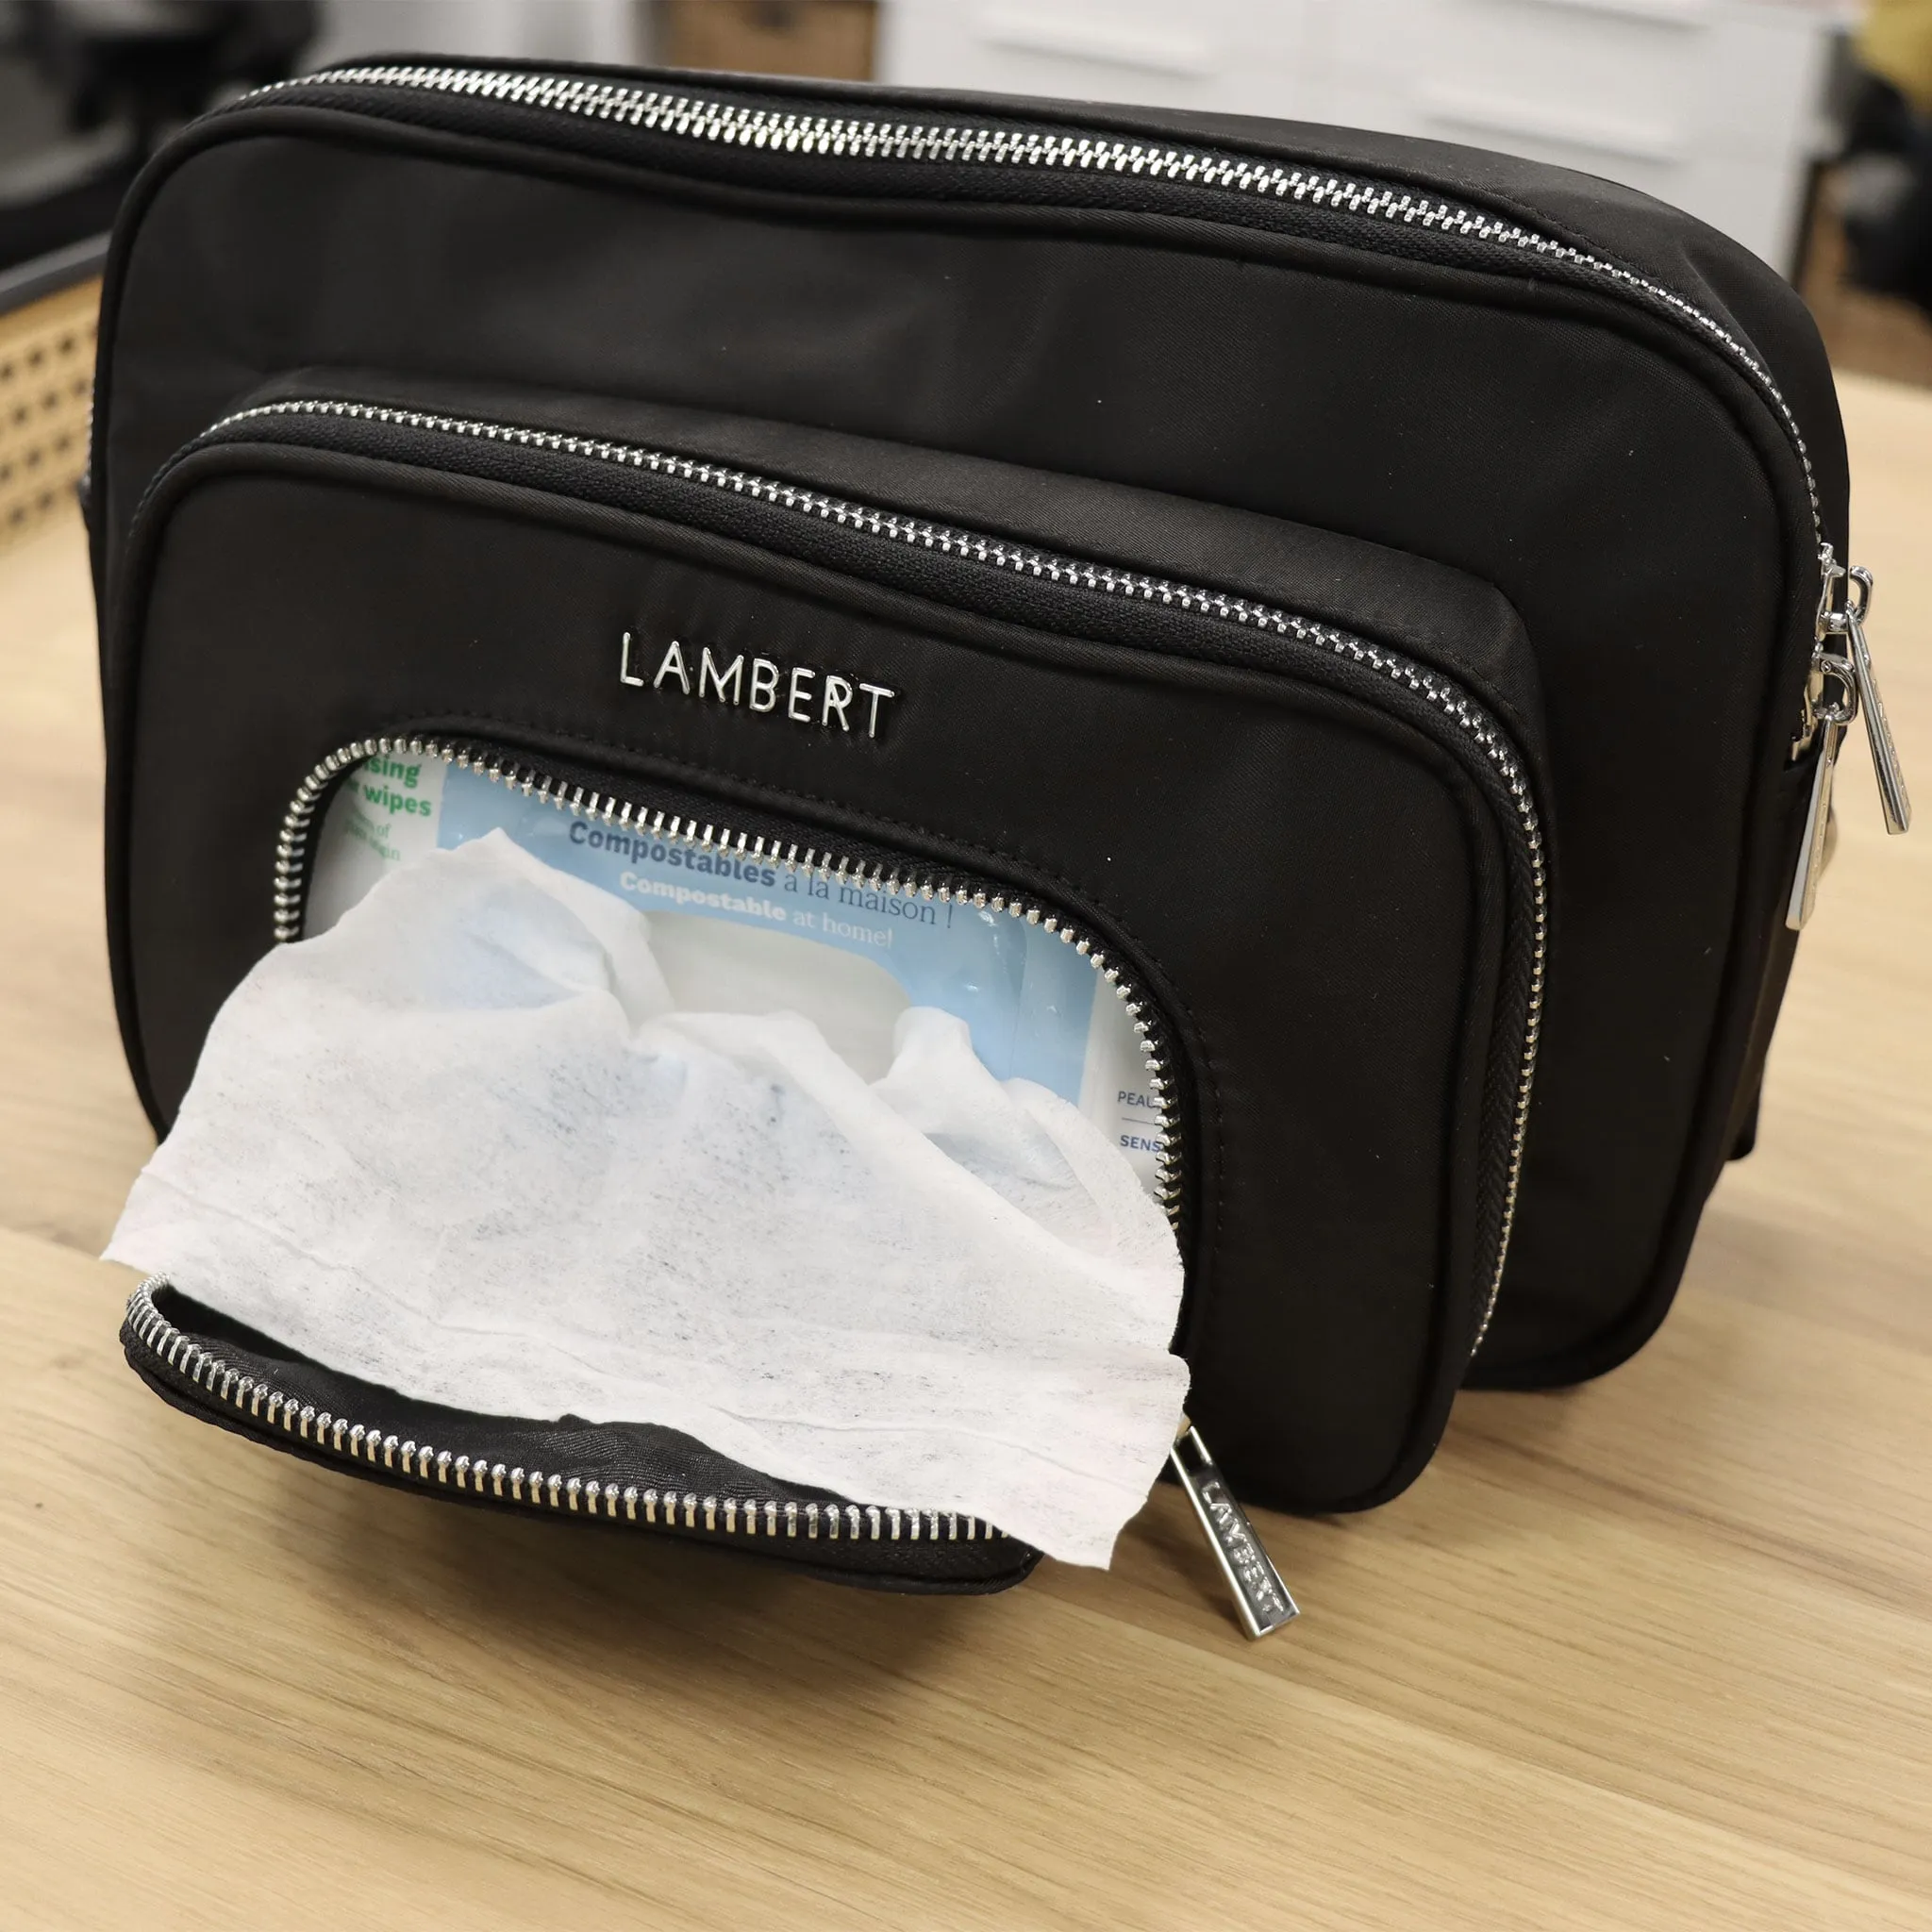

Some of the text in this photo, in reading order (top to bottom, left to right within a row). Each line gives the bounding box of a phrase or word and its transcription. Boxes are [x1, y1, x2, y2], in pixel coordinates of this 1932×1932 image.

[619, 631, 895, 739] LAMBERT
[362, 784, 432, 817] wipes
[569, 821, 776, 888] Compostables
[807, 871, 829, 900] la
[839, 881, 936, 925] maison
[619, 871, 892, 949] Compostable at home!
[1201, 1480, 1285, 1614] LAMBERT
